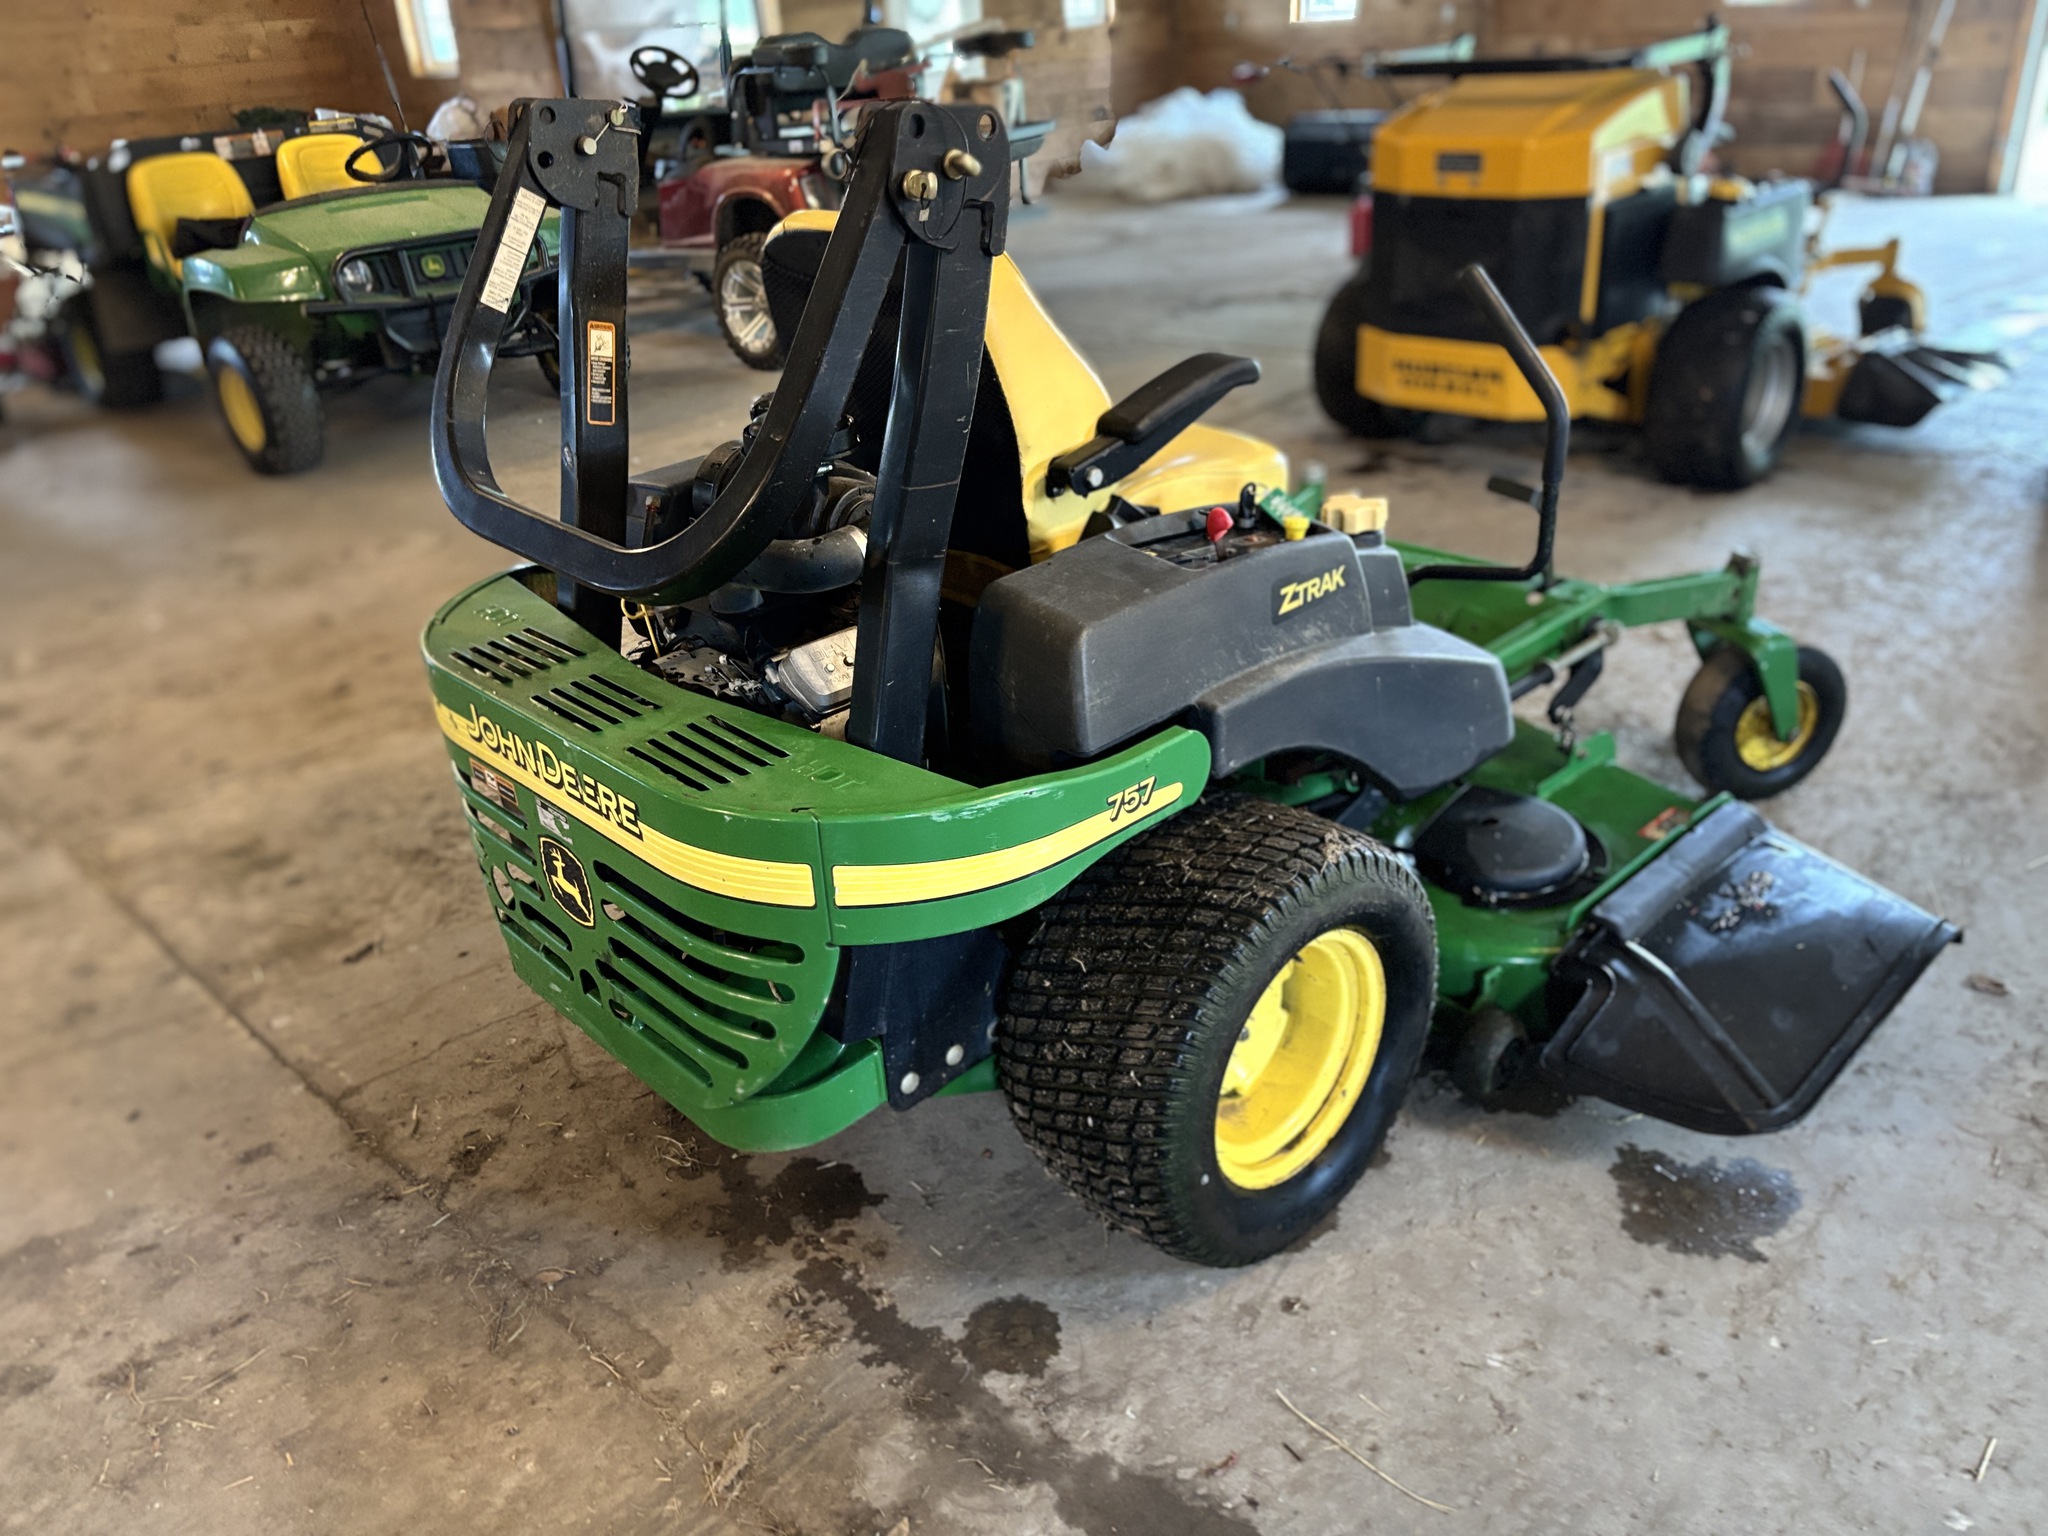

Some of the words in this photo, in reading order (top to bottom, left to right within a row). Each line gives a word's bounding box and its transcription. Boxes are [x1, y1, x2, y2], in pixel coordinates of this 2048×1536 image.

[1278, 564, 1346, 616] ZTRAK
[467, 703, 541, 779] JOHN
[536, 739, 644, 842] DEERE
[1106, 775, 1157, 822] 757
